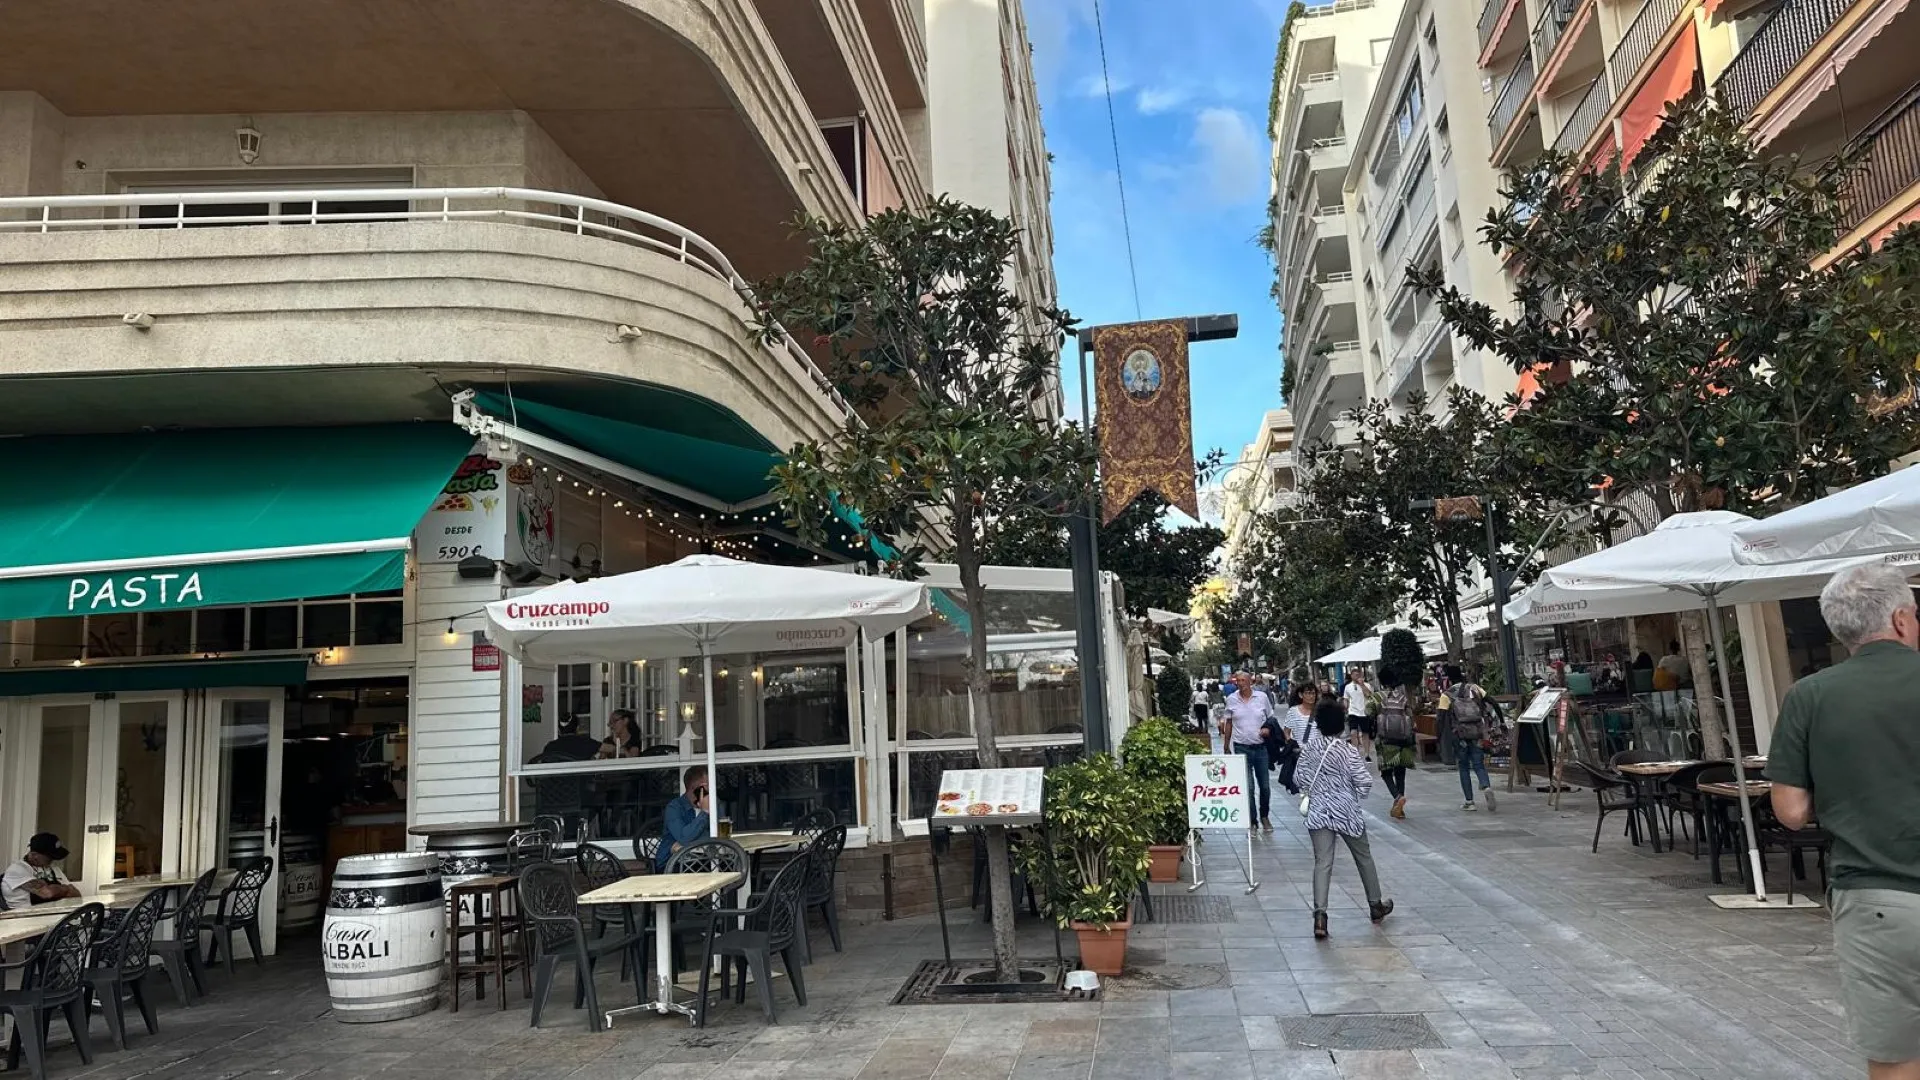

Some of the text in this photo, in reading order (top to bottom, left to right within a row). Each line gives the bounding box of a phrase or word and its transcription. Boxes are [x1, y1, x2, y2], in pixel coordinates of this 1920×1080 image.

[443, 472, 499, 495] asta
[444, 526, 473, 535] DESDE
[67, 571, 203, 611] PASTA
[506, 601, 610, 619] Cruzcampo
[1192, 785, 1241, 802] Pizza
[1199, 807, 1240, 825] 5,90 €
[326, 921, 377, 941] Casa
